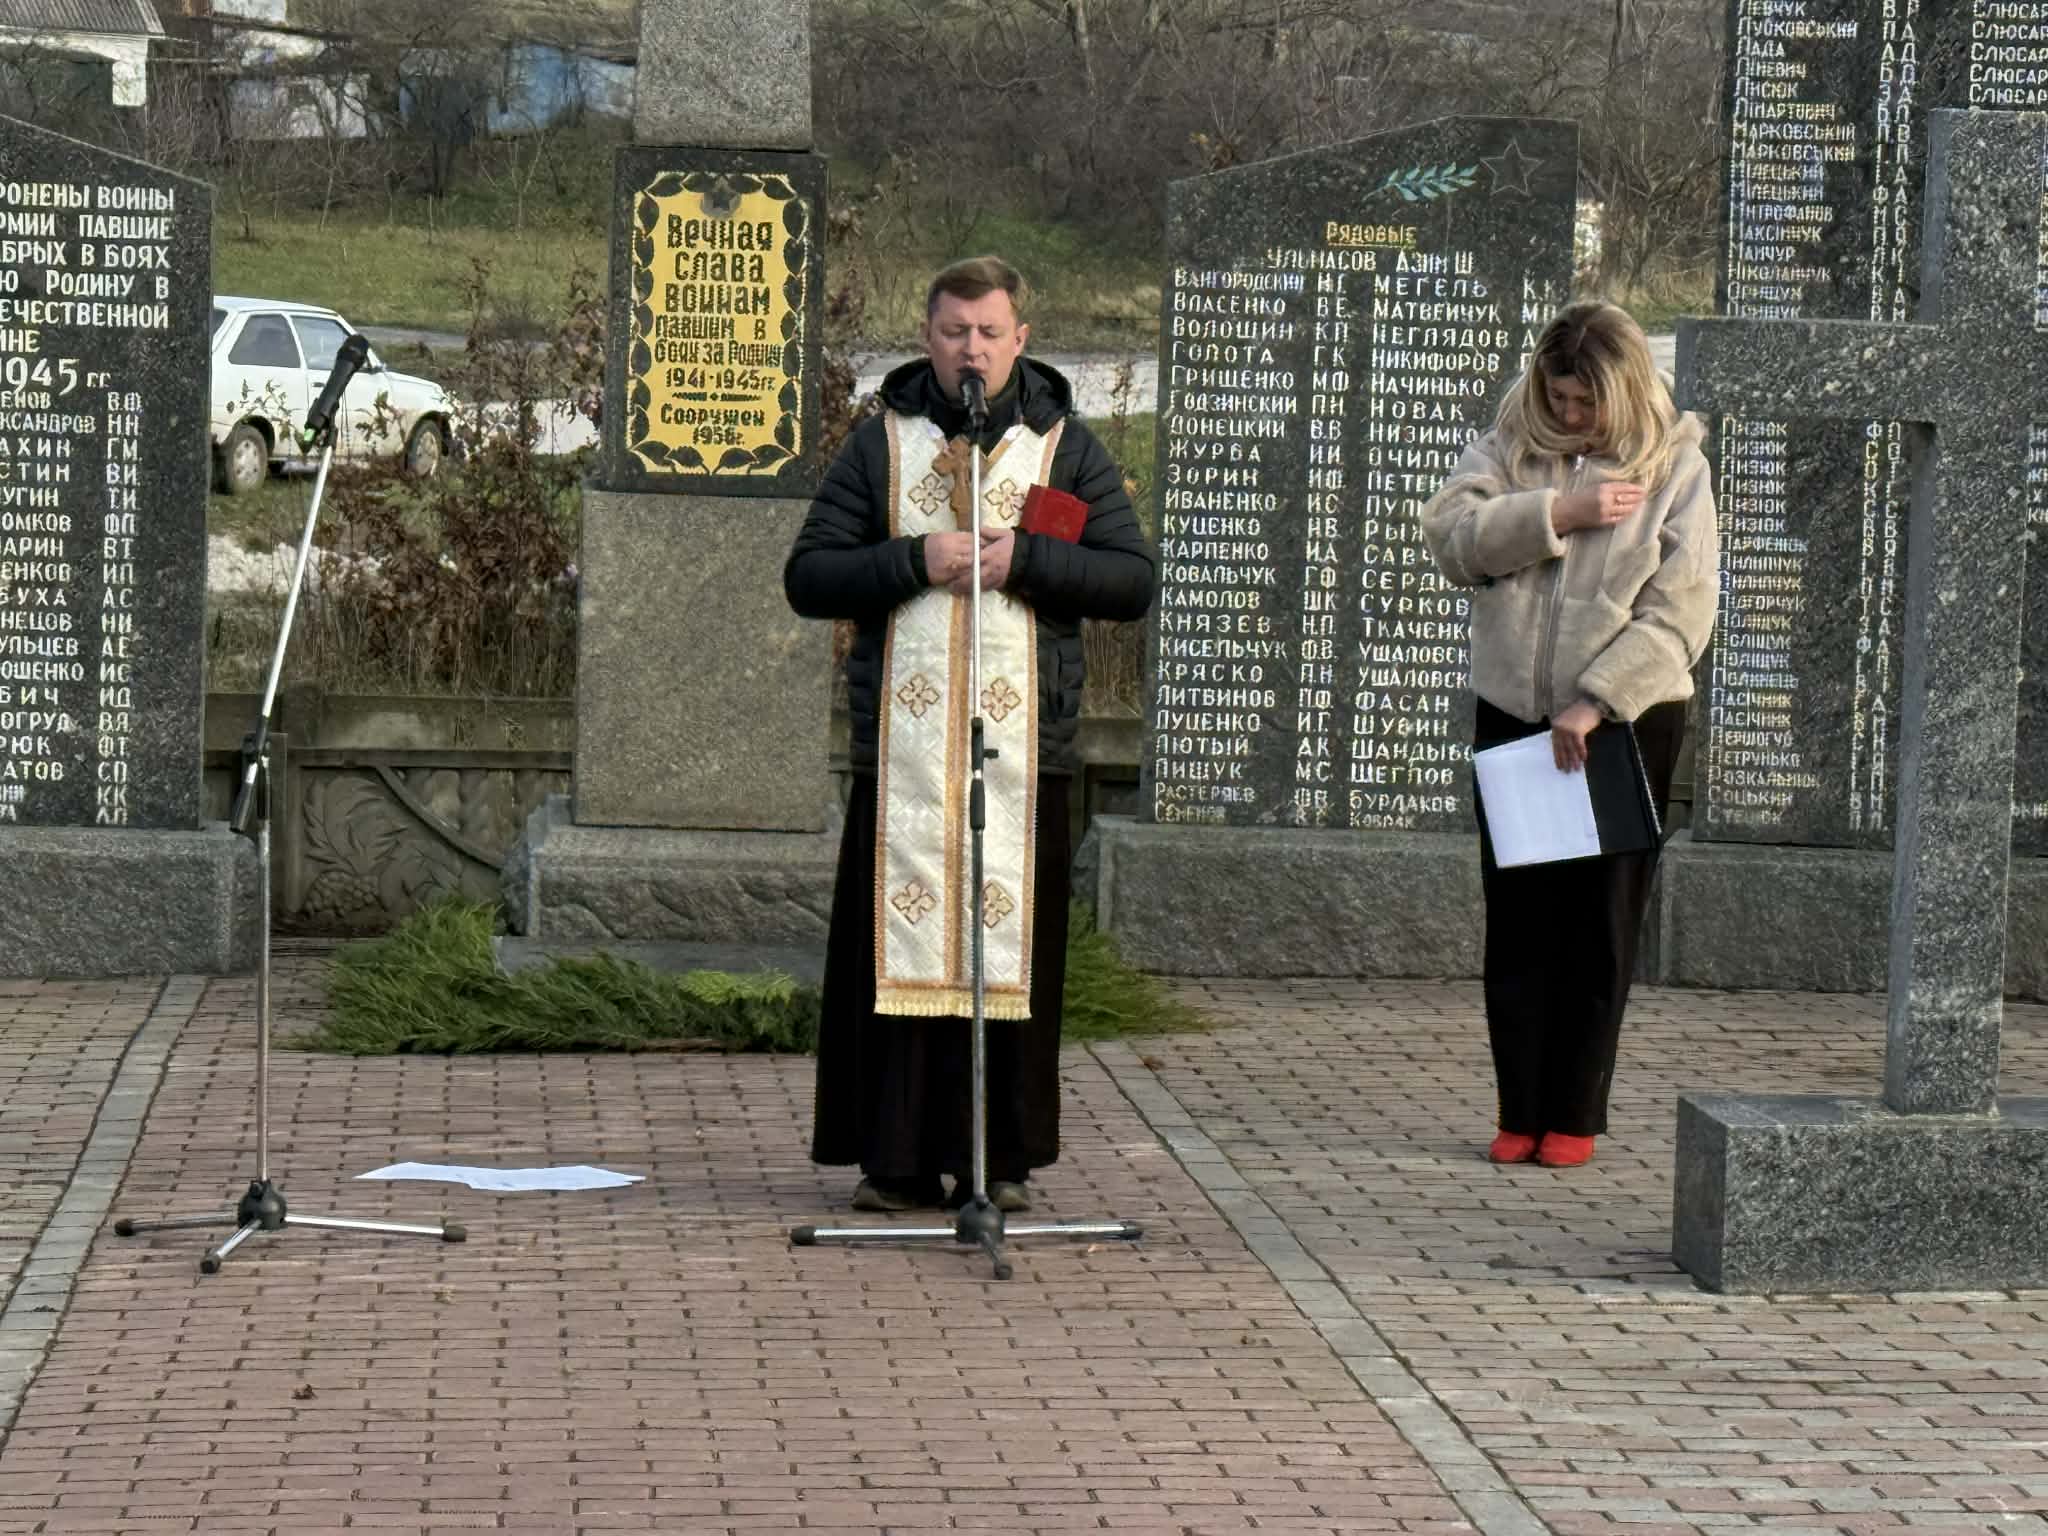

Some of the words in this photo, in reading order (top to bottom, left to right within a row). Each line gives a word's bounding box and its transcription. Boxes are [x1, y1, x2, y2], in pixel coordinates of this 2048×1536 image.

[97, 186, 174, 211] ВОИНЫ
[79, 214, 174, 240] ПАВШИЕ
[82, 243, 95, 267] В
[104, 245, 171, 269] БОЯХ
[46, 270, 134, 297] РОДИНУ
[156, 275, 169, 300] В
[1174, 292, 1286, 315] ВЛАСЕНКО
[1173, 316, 1293, 341] ВОЛОШИН
[1372, 324, 1509, 348] НЕГЛЯДОВ
[1172, 341, 1275, 364] ГОЛОТА
[1371, 348, 1501, 372] НИКИФОРОВ
[1371, 373, 1486, 397] НАЧИНЬКО
[1370, 397, 1465, 421] НОВАК
[1168, 439, 1261, 462] ЖУРБА
[1167, 464, 1258, 487] ЗОРИН
[0, 486, 59, 507] УГИН
[1165, 488, 1277, 512] ИВАНЕНКО
[1164, 513, 1261, 535] КУЦЕНКО
[0, 537, 63, 557] АРИН
[1162, 538, 1269, 561] КАРПЕНКО
[1161, 562, 1276, 585] КОВАЛЬЧУК
[1161, 586, 1260, 608] КАМОЛОВ
[1360, 593, 1470, 616] СУРКОВ
[1160, 610, 1271, 634] КНЯЗЕВ
[1157, 659, 1263, 683] КРЯСКО
[1156, 685, 1276, 708] ЛИТВИНОВ
[1355, 690, 1450, 713] ФАСАН
[1155, 709, 1261, 732] ЛУЦЕНКО
[1155, 734, 1249, 756] ЛЮТЫЙ
